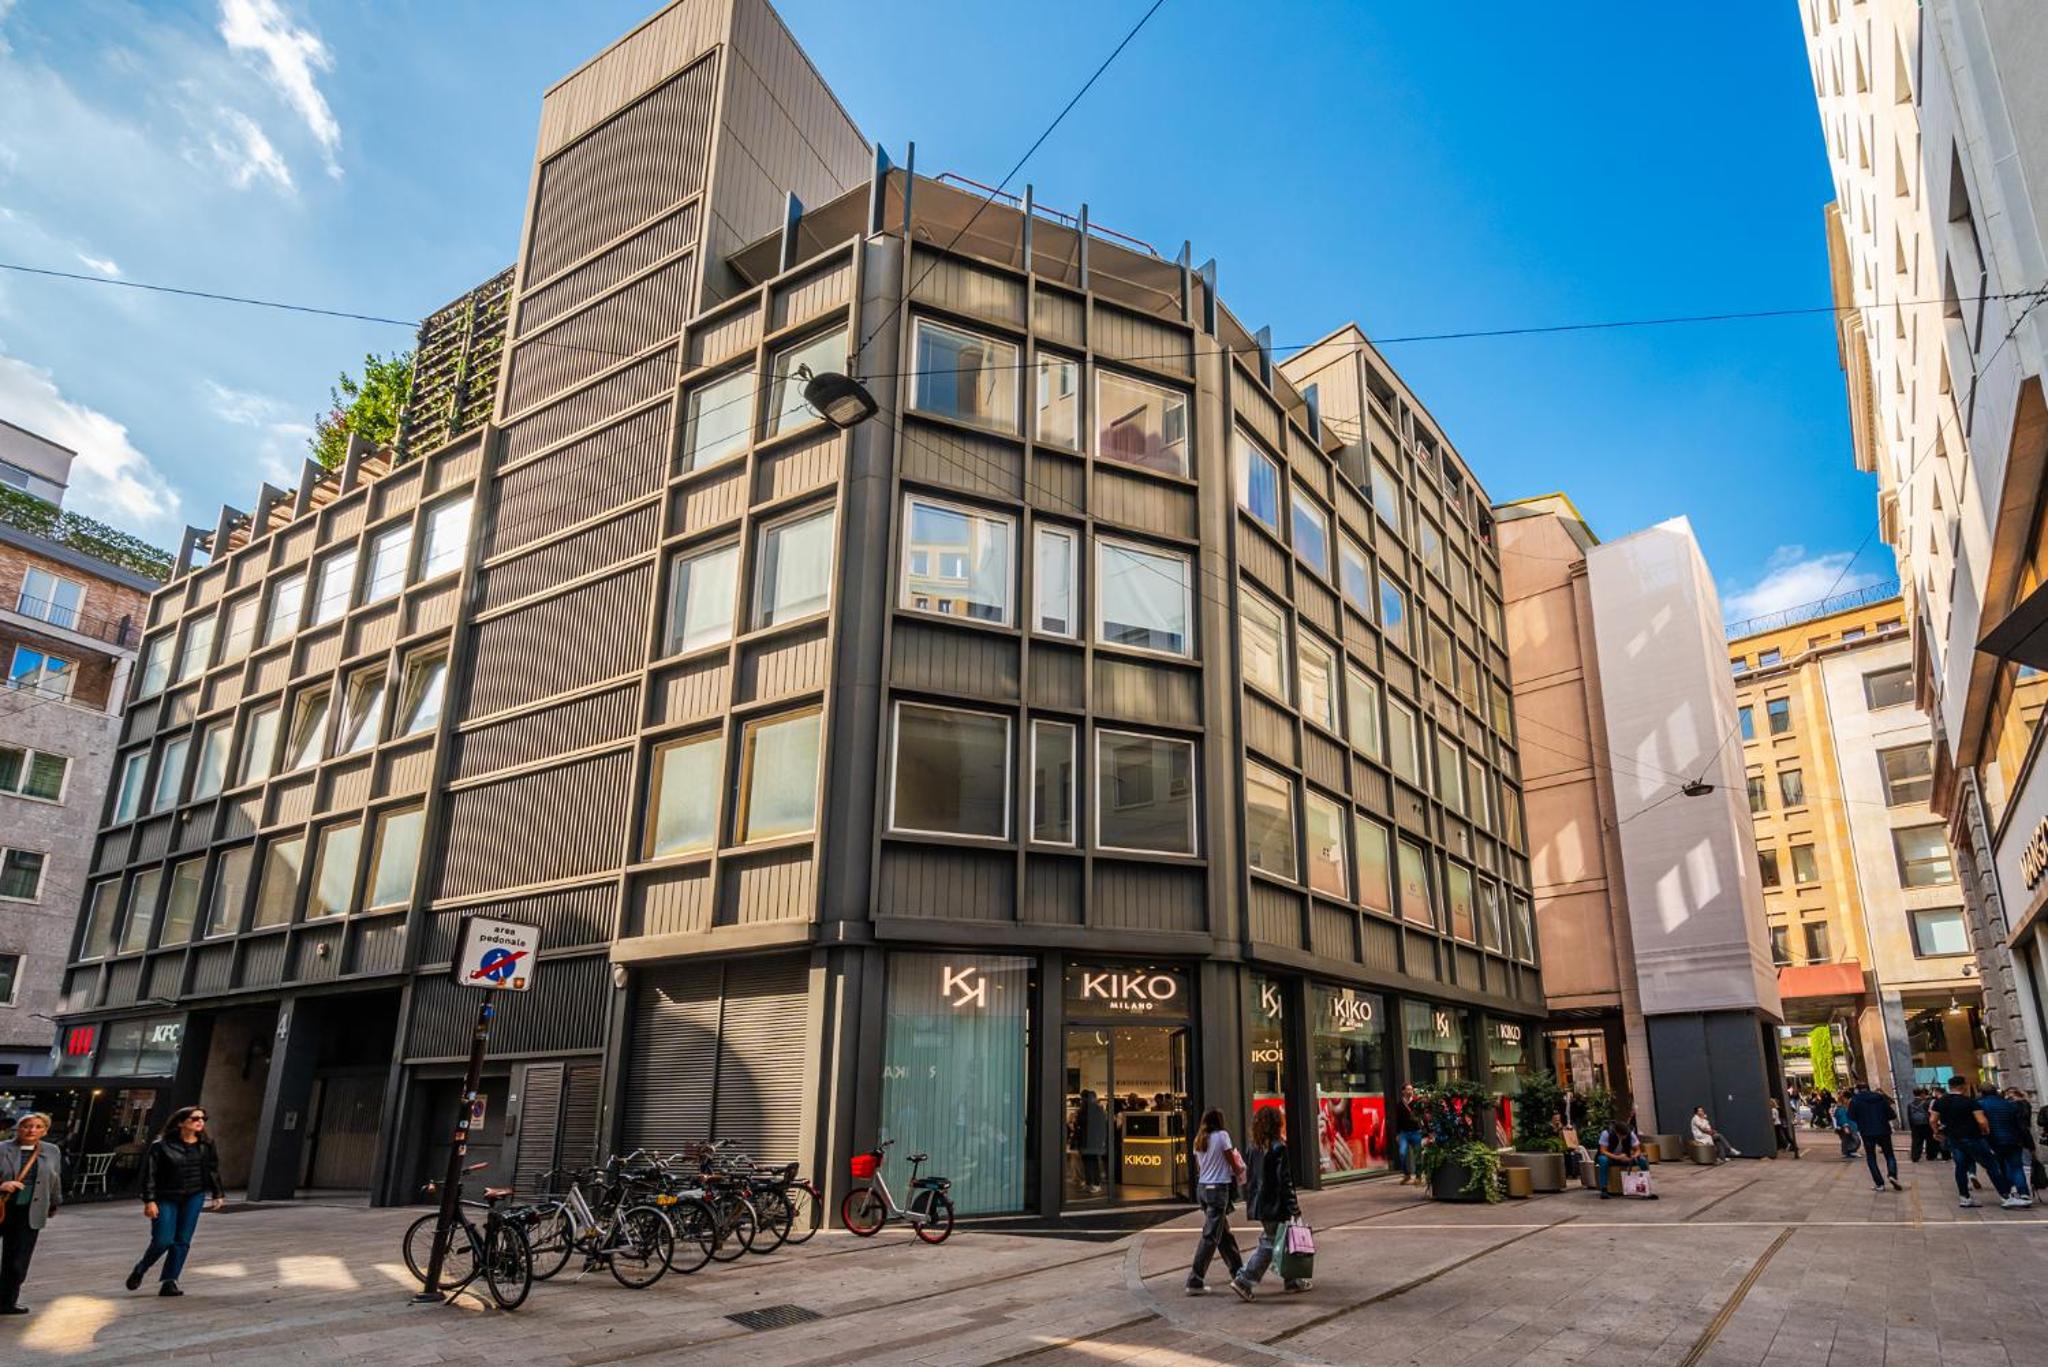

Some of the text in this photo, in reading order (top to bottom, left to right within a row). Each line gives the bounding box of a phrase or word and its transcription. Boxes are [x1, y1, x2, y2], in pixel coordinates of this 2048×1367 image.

[494, 927, 515, 935] area
[479, 934, 526, 947] pedonale
[1083, 973, 1176, 1000] KIKO
[1110, 1001, 1153, 1010] MILANO
[1334, 998, 1372, 1020] KIKO
[152, 1024, 180, 1042] KFC
[277, 1013, 287, 1038] 4
[1500, 1024, 1520, 1040] KIKO
